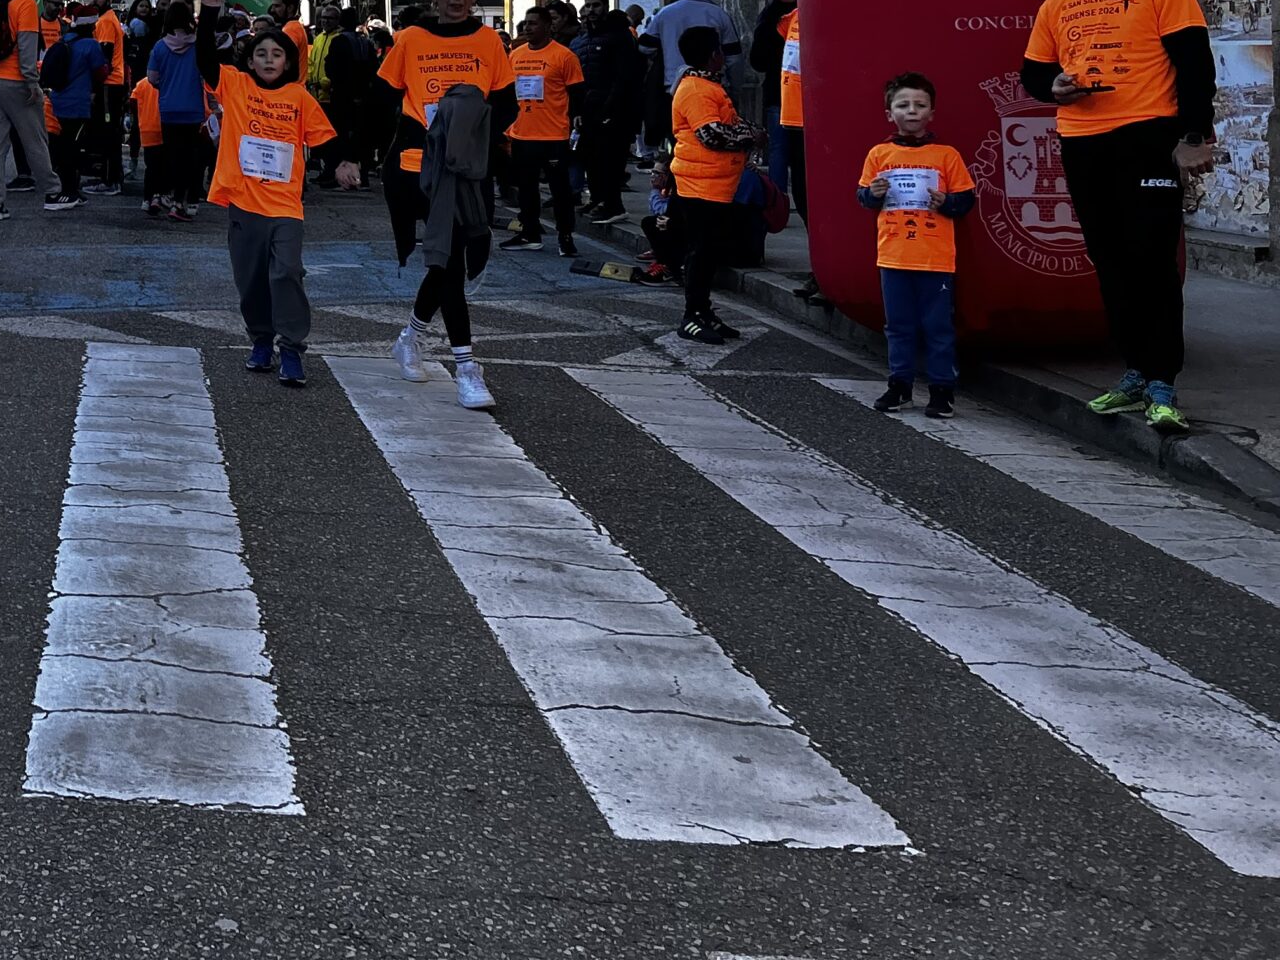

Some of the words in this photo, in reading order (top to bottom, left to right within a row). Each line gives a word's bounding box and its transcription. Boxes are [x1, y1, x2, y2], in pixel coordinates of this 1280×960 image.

[1068, 0, 1081, 9] SAN
[1061, 9, 1097, 24] TUDENSE
[1098, 6, 1119, 15] 2024
[425, 53, 439, 61] SAN
[419, 64, 453, 73] TUDENSE
[455, 64, 473, 72] 2024
[276, 114, 293, 122] 2024
[1140, 178, 1178, 188] LEGEA
[987, 212, 1059, 271] MUNICÍPIO
[1062, 255, 1084, 272] DE
